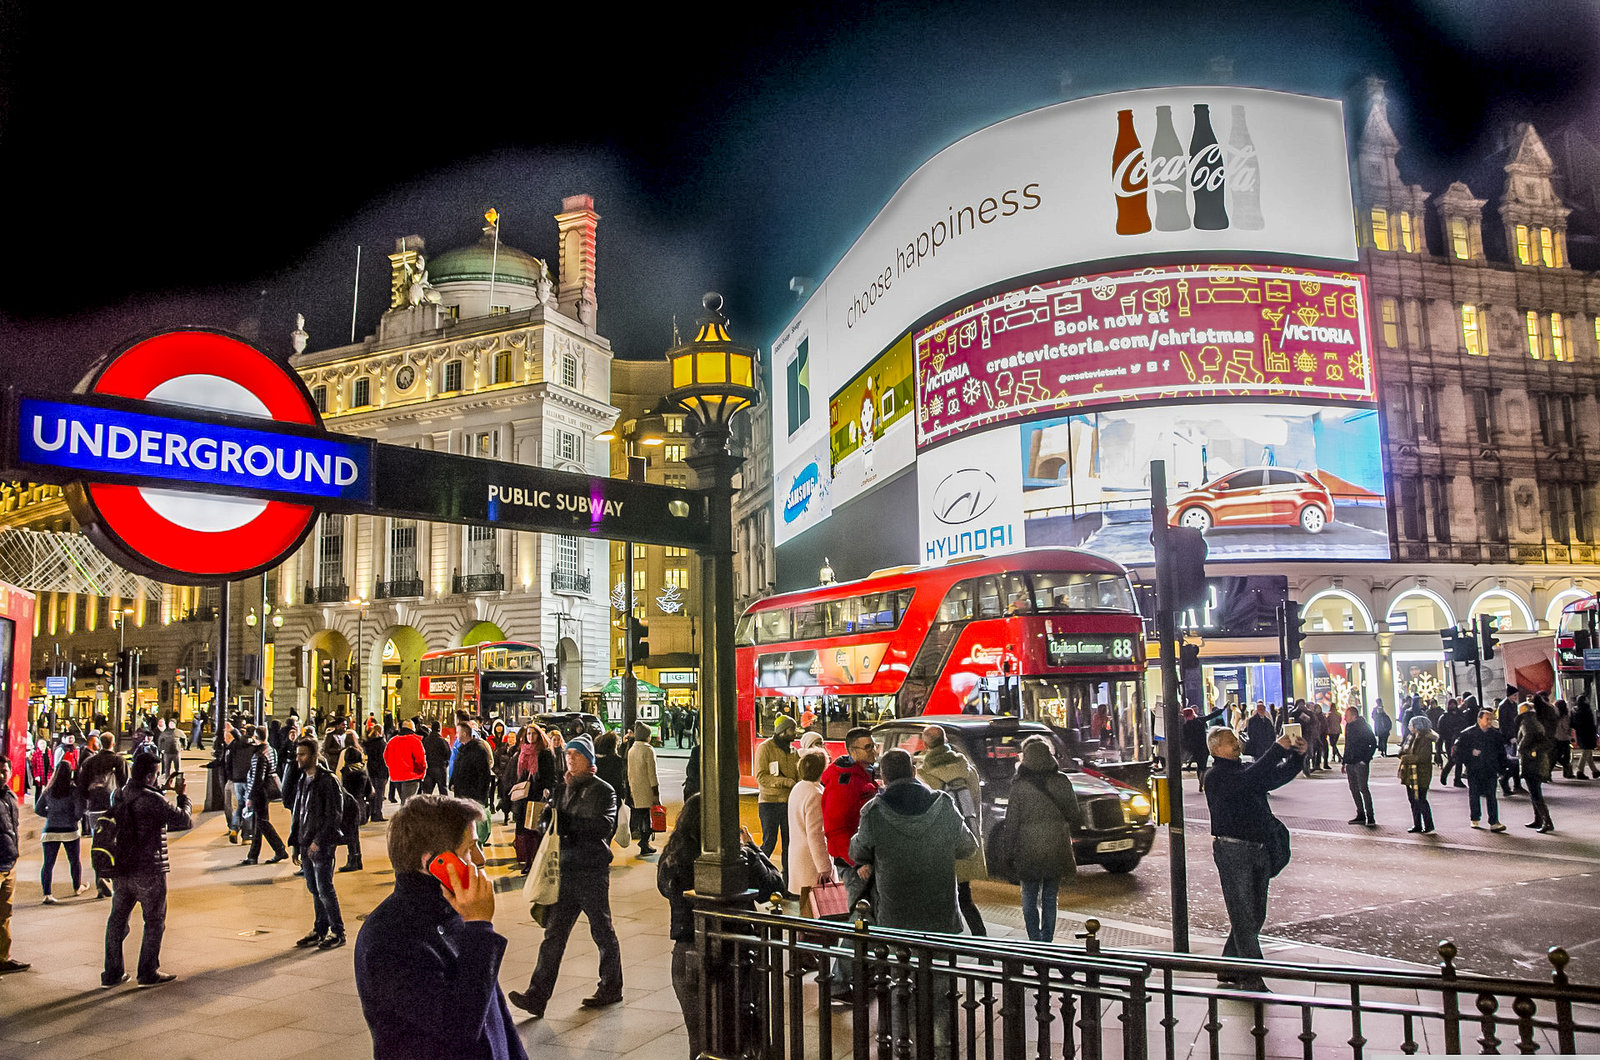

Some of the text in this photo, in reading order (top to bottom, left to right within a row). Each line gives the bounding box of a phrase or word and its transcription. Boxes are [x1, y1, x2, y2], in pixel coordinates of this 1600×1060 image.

[847, 182, 1042, 329] choose happiness
[1054, 308, 1169, 336] Book now at
[986, 327, 1255, 373] createvictoria.com/christmas
[1059, 366, 1127, 384] @createvictoria
[33, 415, 359, 486] UNDERGROUND
[488, 484, 624, 517] PUBLIC SUBWAY
[787, 476, 815, 510] SAMSUNG
[926, 524, 1012, 562] HYUNDAI
[1050, 641, 1104, 656] Clapham Common
[1113, 639, 1132, 658] 88
[492, 681, 517, 689] Aldwych
